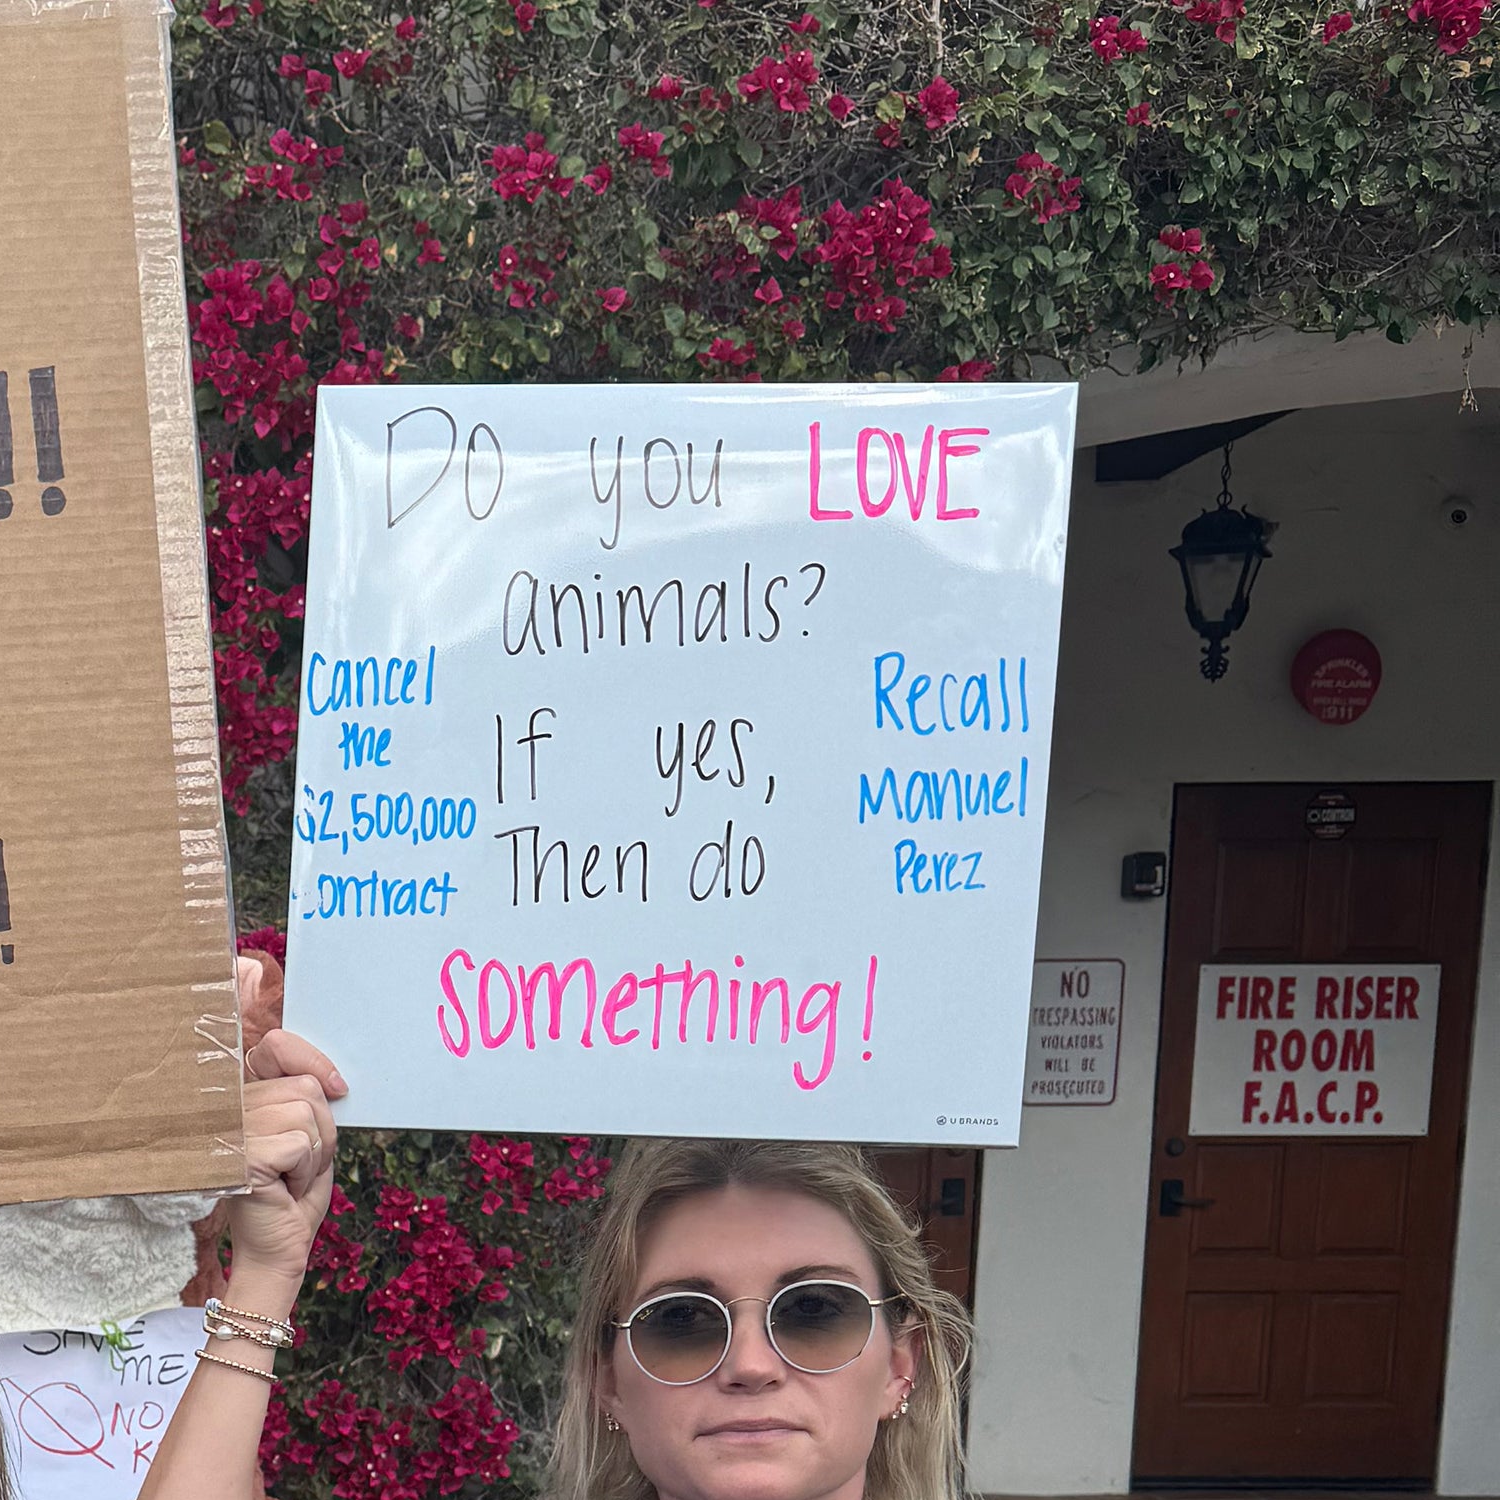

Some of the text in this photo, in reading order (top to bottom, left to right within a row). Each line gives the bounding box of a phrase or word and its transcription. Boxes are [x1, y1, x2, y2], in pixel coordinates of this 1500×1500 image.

[589, 434, 724, 550] you
[808, 421, 990, 521] LOVE
[873, 651, 1029, 736] Recall
[338, 721, 392, 771] the
[495, 708, 776, 816] If yes,
[858, 756, 1029, 825] Manuel
[494, 820, 766, 907] Then do
[893, 839, 986, 895] Perez
[292, 870, 458, 920] ontract
[1060, 969, 1090, 999] NO
[1216, 975, 1421, 1020] FIRE RISER
[1031, 1006, 1116, 1027] TRESPASSING
[1040, 1034, 1104, 1050] VIOLATORS
[1252, 1028, 1375, 1073] ROOM
[1045, 1057, 1096, 1073] WILL BE
[1031, 1080, 1106, 1096] PROSECUTED
[1241, 1080, 1384, 1125] F.A.C.P.
[120, 1353, 188, 1386] ME
[110, 1400, 165, 1436] NO
